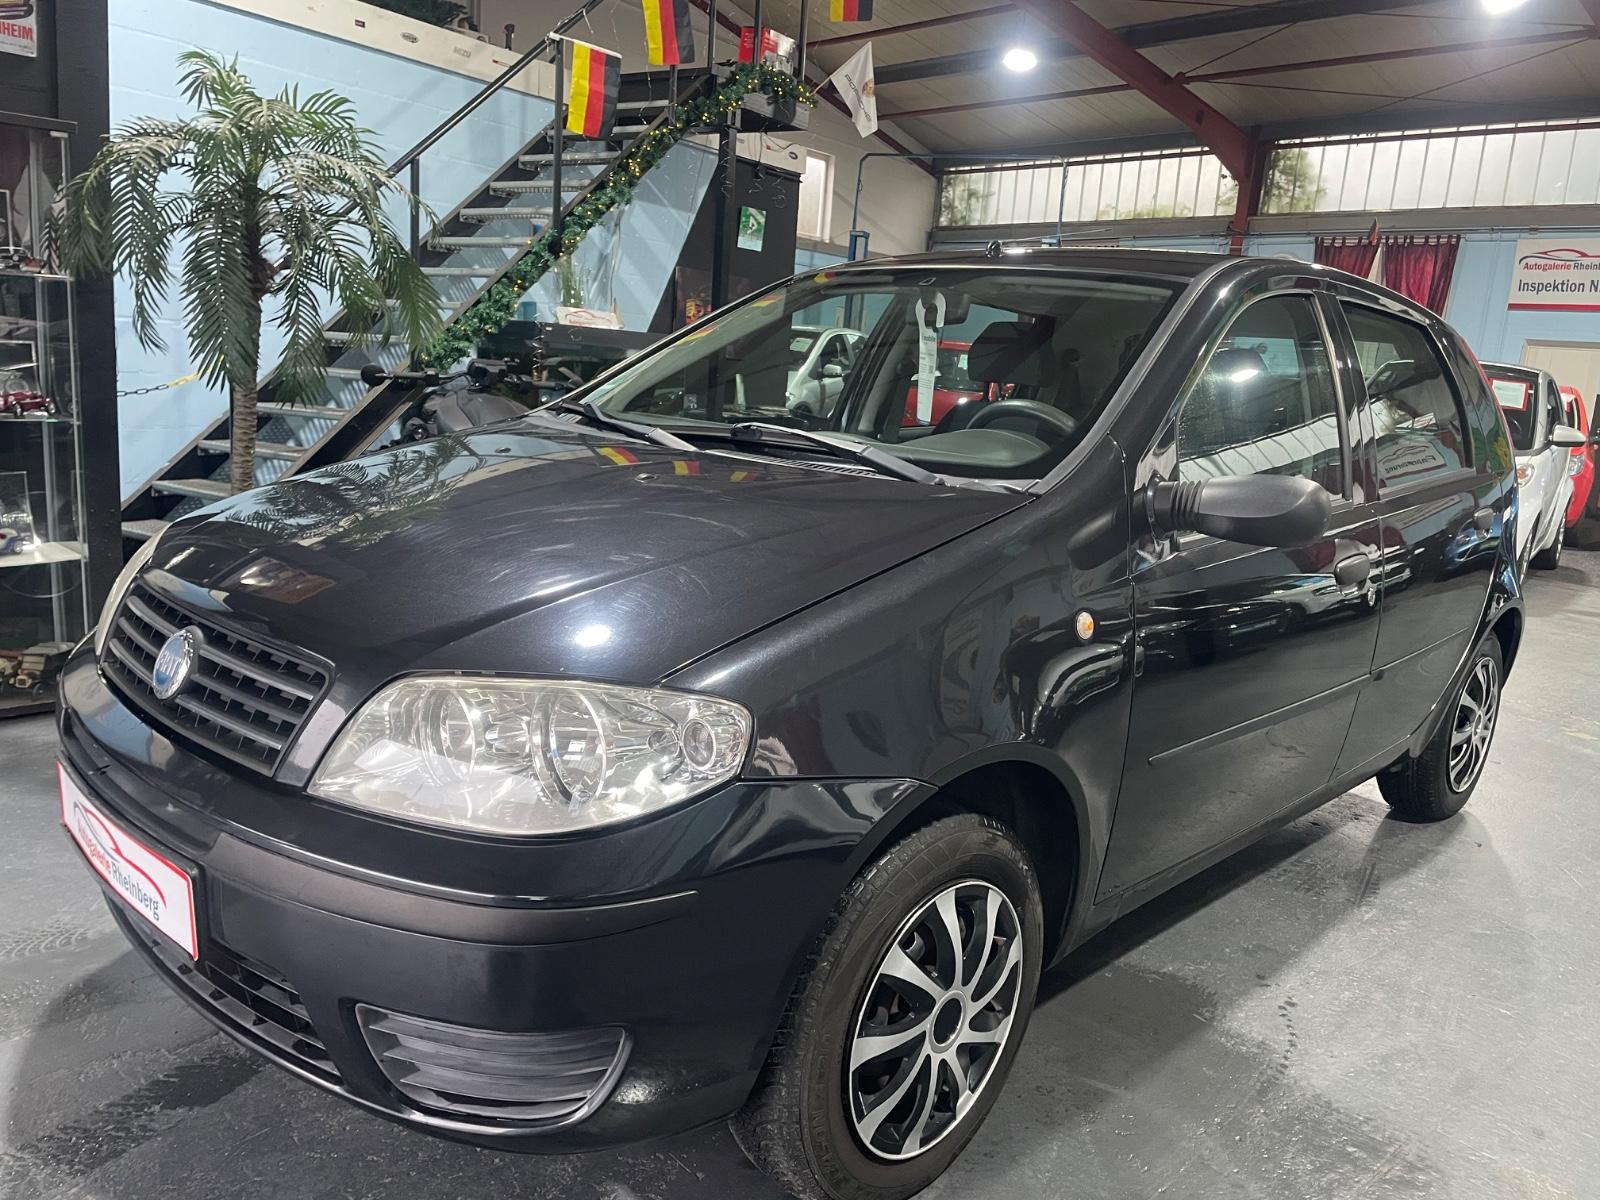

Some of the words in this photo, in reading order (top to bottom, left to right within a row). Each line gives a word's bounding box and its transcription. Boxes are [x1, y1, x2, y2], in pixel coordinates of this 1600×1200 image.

[0, 20, 33, 42] HEIM
[845, 73, 872, 122] PORSCHE
[1523, 262, 1571, 272] Autogalerie
[1573, 261, 1600, 271] Rhein
[1518, 279, 1585, 295] Inspektion
[1589, 279, 1600, 293] N
[111, 860, 160, 921] Rheinberg
